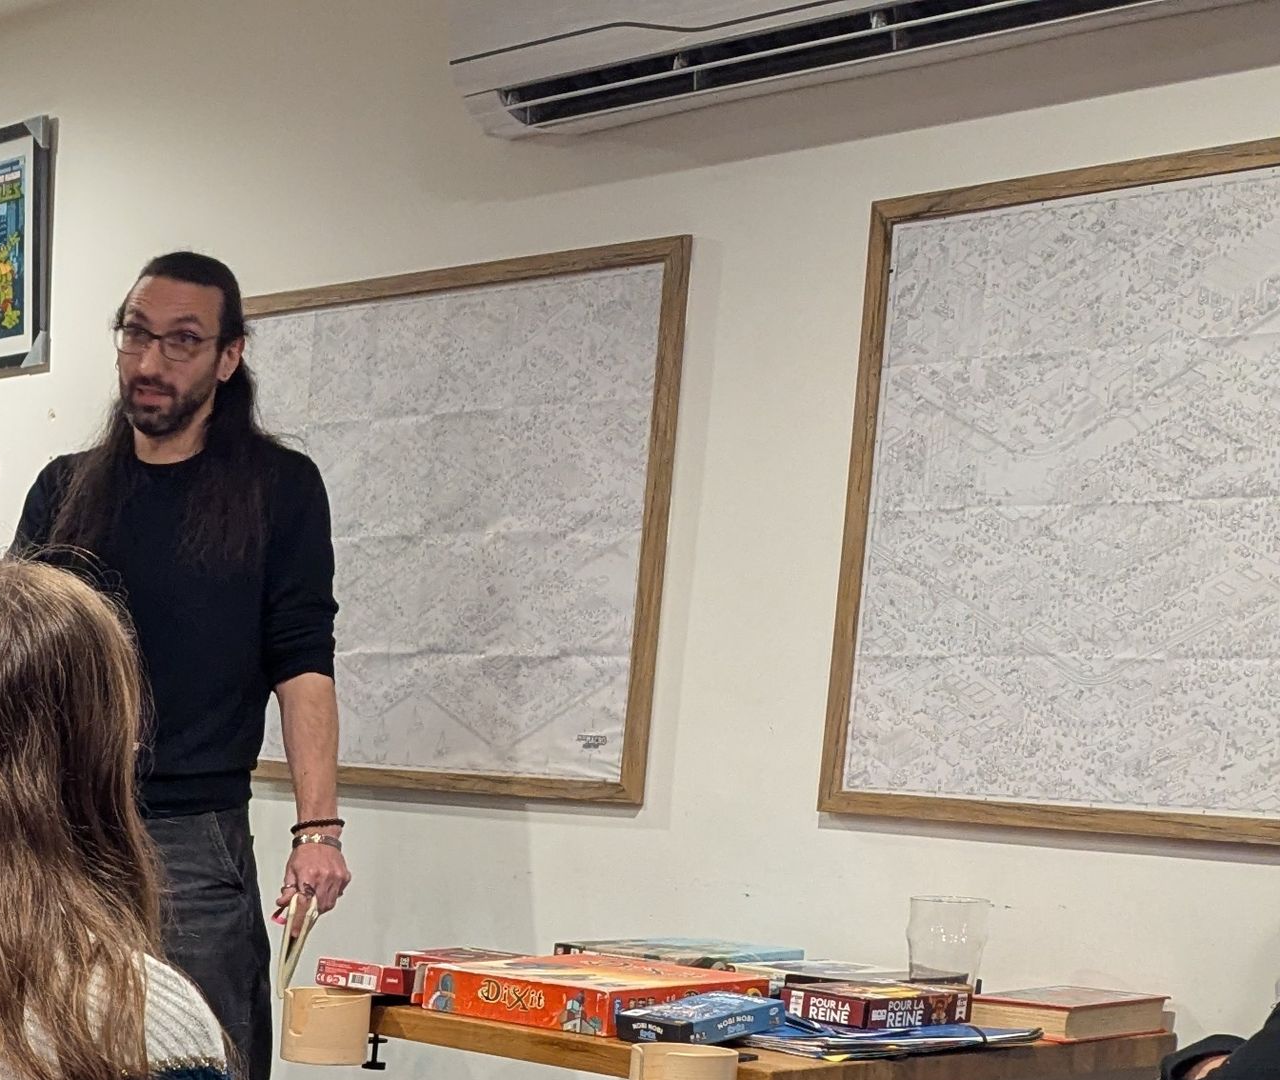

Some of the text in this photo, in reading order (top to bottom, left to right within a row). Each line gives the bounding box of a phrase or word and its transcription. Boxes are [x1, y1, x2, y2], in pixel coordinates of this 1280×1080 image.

[810, 997, 836, 1009] POUR
[838, 1001, 851, 1012] LA
[888, 1000, 925, 1011] POUR LA
[717, 1016, 735, 1030] NOBI
[736, 1014, 755, 1022] NOBI
[809, 1006, 850, 1025] REINE
[886, 1010, 924, 1028] REINE
